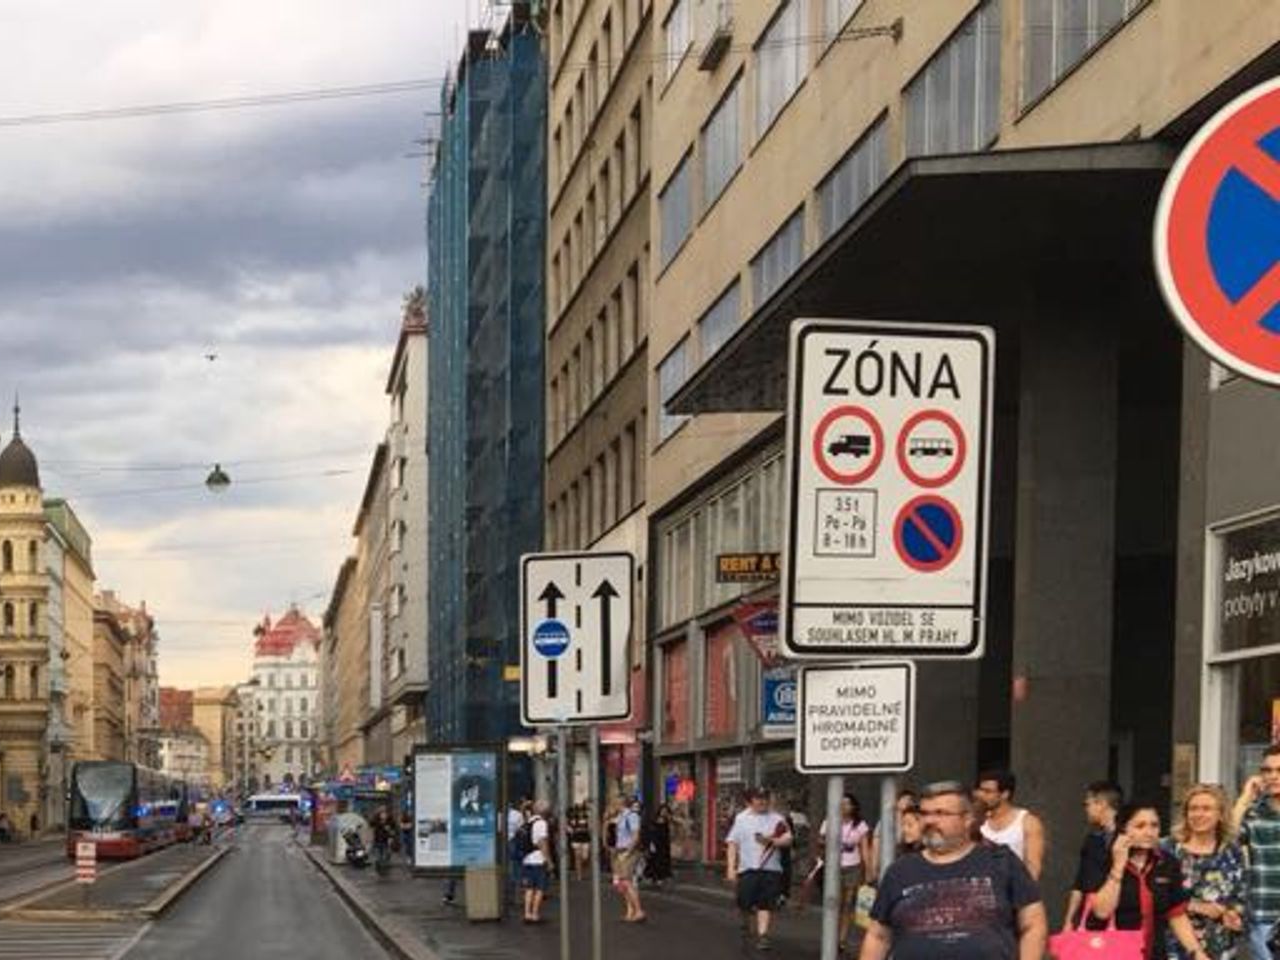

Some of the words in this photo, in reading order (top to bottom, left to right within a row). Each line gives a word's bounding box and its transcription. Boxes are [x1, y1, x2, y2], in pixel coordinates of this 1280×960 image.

[822, 340, 961, 399] ZÓNA
[720, 556, 758, 571] RENT
[761, 554, 771, 570] A
[1224, 588, 1266, 620] pobyty
[832, 610, 865, 626] MIMO
[869, 610, 914, 627] VOZIDEL
[920, 612, 937, 627] SE
[807, 627, 879, 643] SOUHLASEM
[919, 629, 960, 645] PRAHY
[836, 685, 877, 699] MIMO
[807, 701, 902, 718] PRAVIDELNÉ
[812, 718, 899, 735] HROMADNÉ
[820, 737, 890, 752] DOPRAVY
